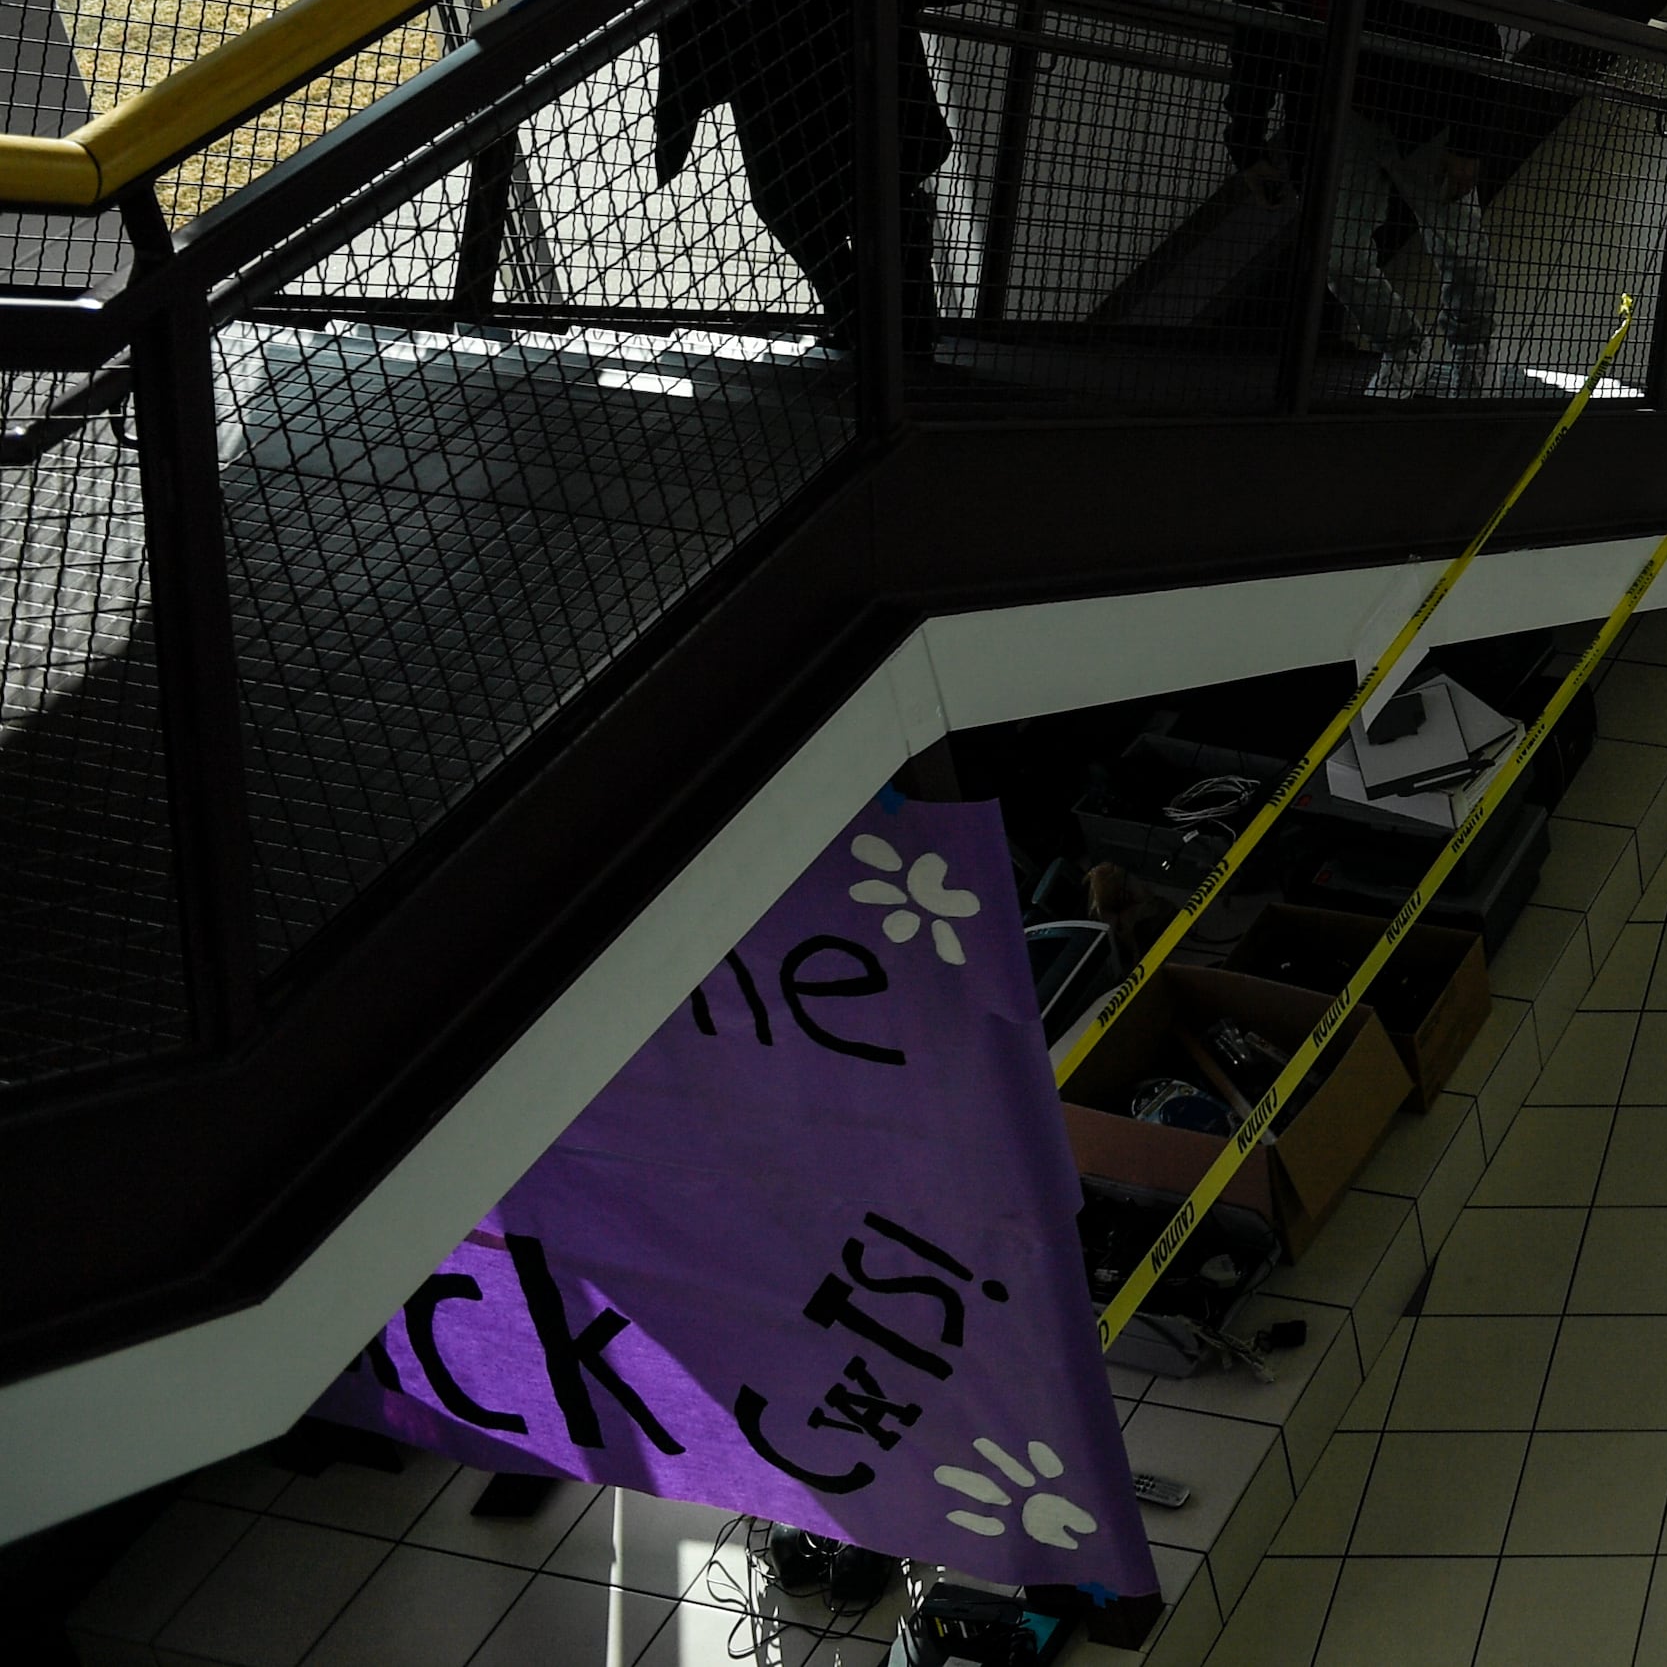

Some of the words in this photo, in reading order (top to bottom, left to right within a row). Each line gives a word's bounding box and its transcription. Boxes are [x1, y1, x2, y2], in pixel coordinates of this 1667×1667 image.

[1099, 964, 1146, 1027] CAUTION
[1313, 985, 1350, 1048] CAUTION
[1237, 1087, 1278, 1154] CAUTION
[1151, 1201, 1195, 1274] CAUTION
